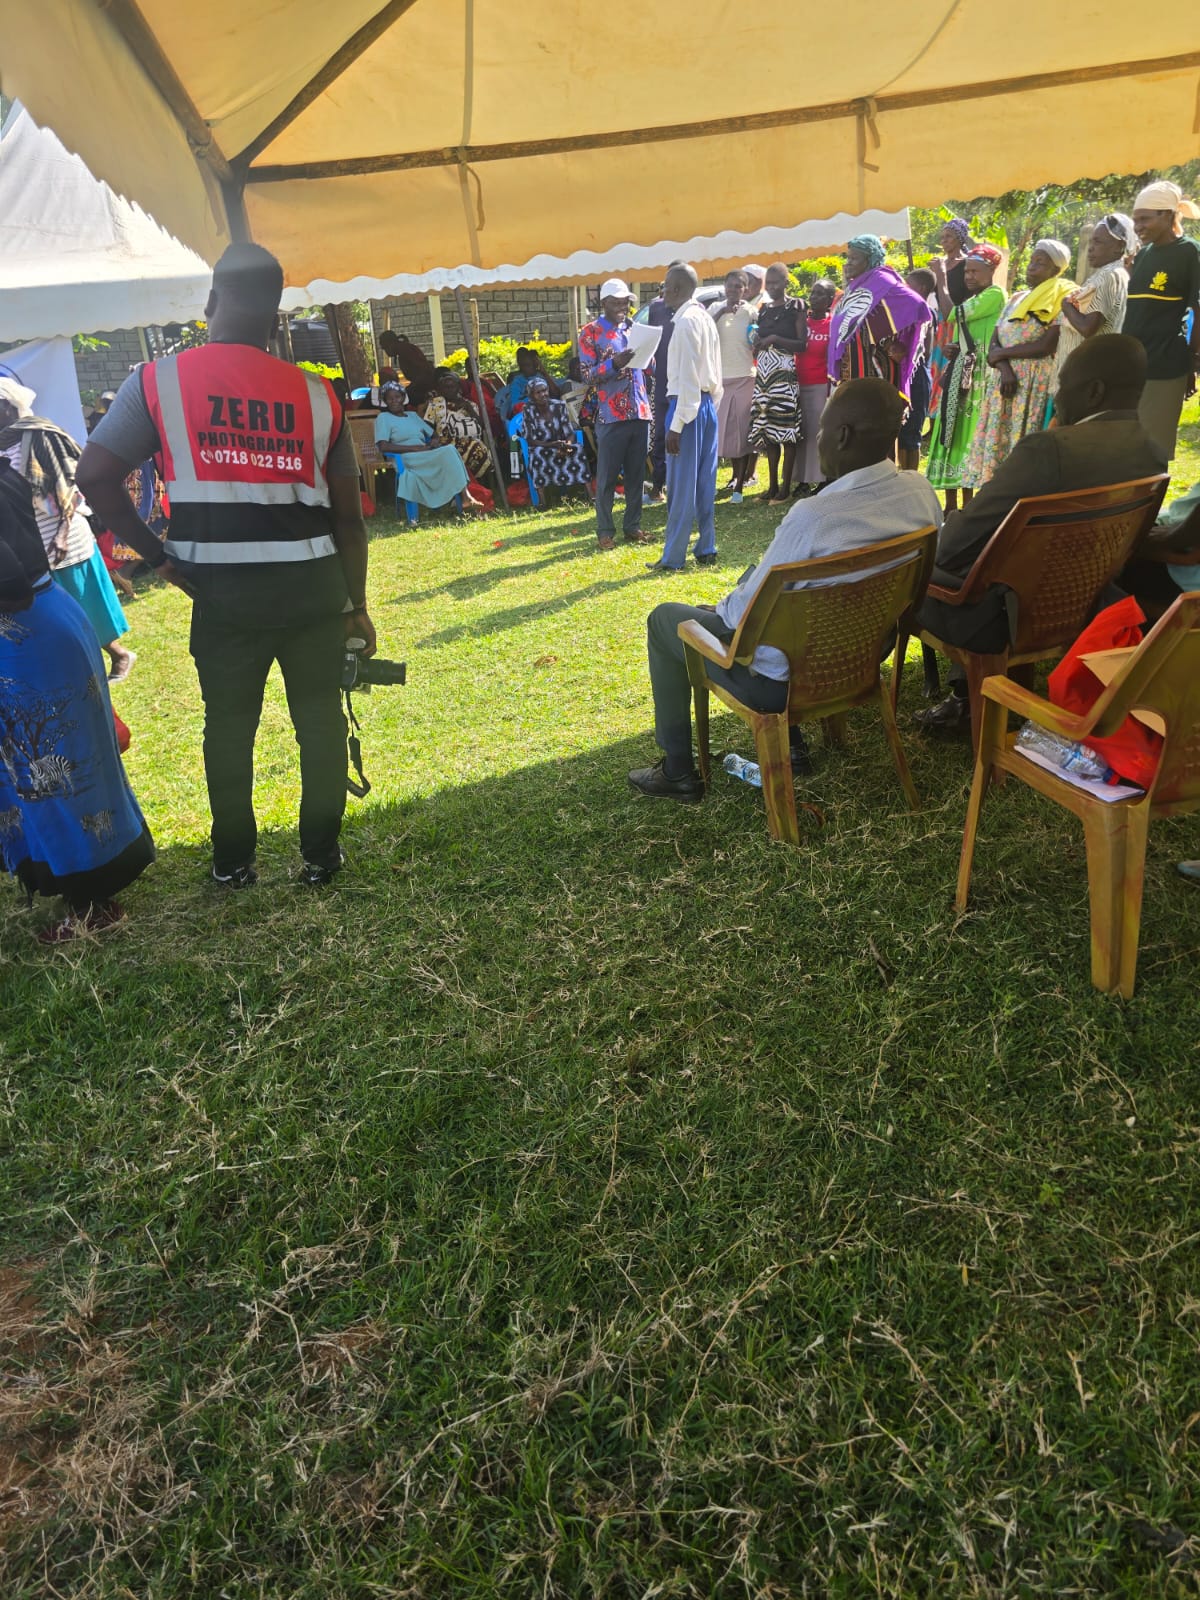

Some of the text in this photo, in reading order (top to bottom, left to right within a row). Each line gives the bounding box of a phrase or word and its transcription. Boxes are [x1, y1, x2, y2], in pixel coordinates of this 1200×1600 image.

[207, 395, 295, 434] ZERU
[197, 432, 304, 454] PHOTOGRAPHY
[215, 450, 303, 471] 0718 022 516
